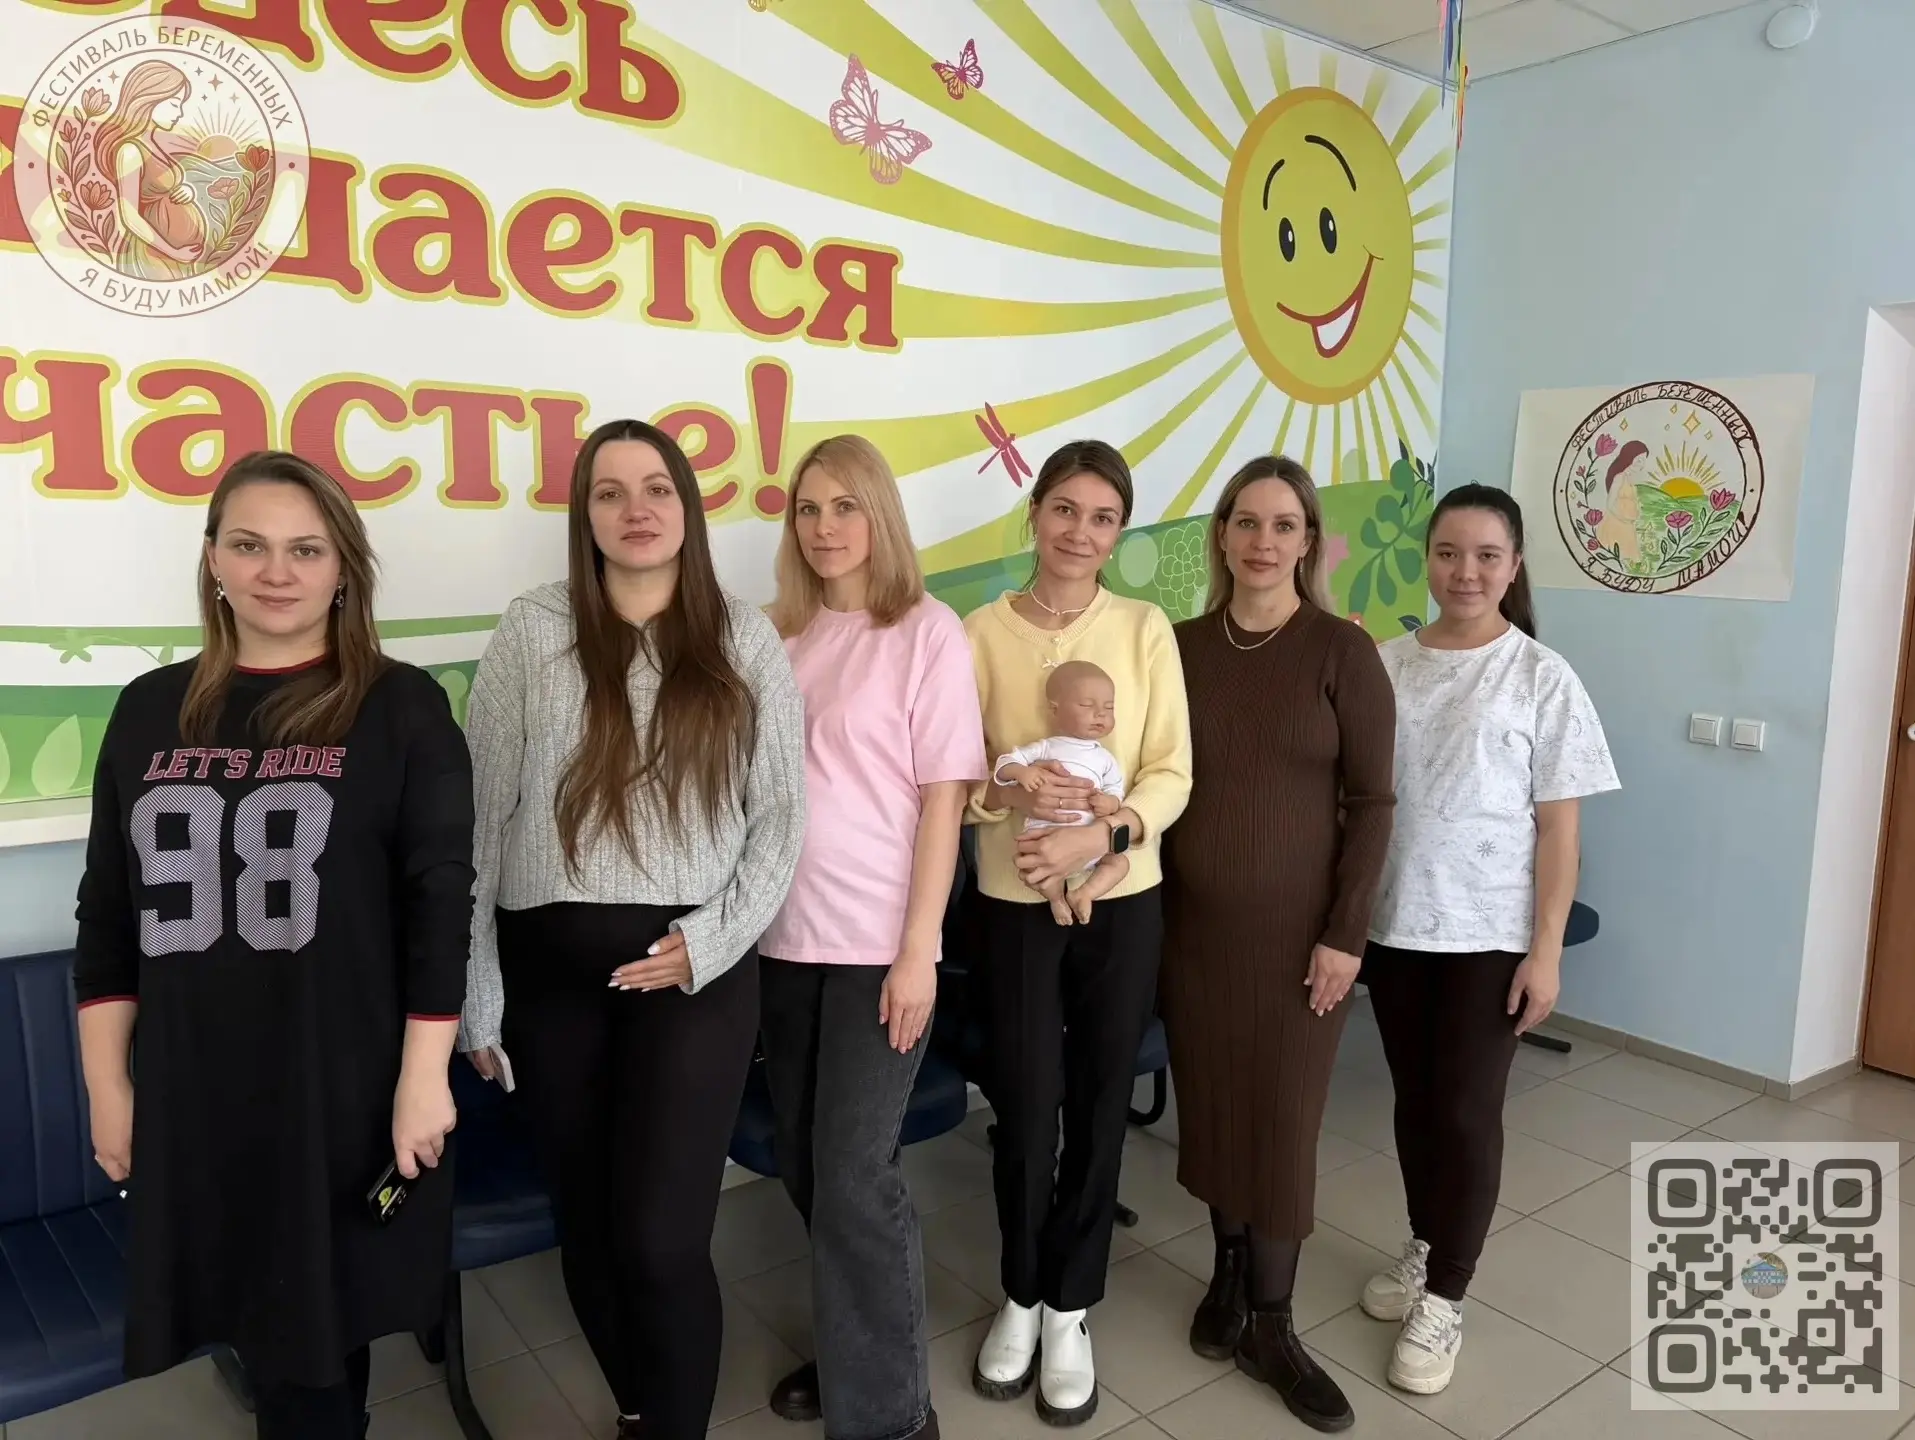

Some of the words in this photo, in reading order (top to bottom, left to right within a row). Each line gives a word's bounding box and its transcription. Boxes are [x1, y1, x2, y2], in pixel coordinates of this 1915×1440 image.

[56, 0, 680, 122] есь
[1570, 387, 1648, 452] ФЕСТИВАЛЬ
[1656, 383, 1753, 449] БЕРЕМЕННЫХ
[1581, 556, 1597, 573] Я
[1598, 568, 1656, 592] БУДУ
[143, 747, 252, 781] LET'S
[255, 744, 347, 778] RIDE
[130, 781, 335, 957] 98
